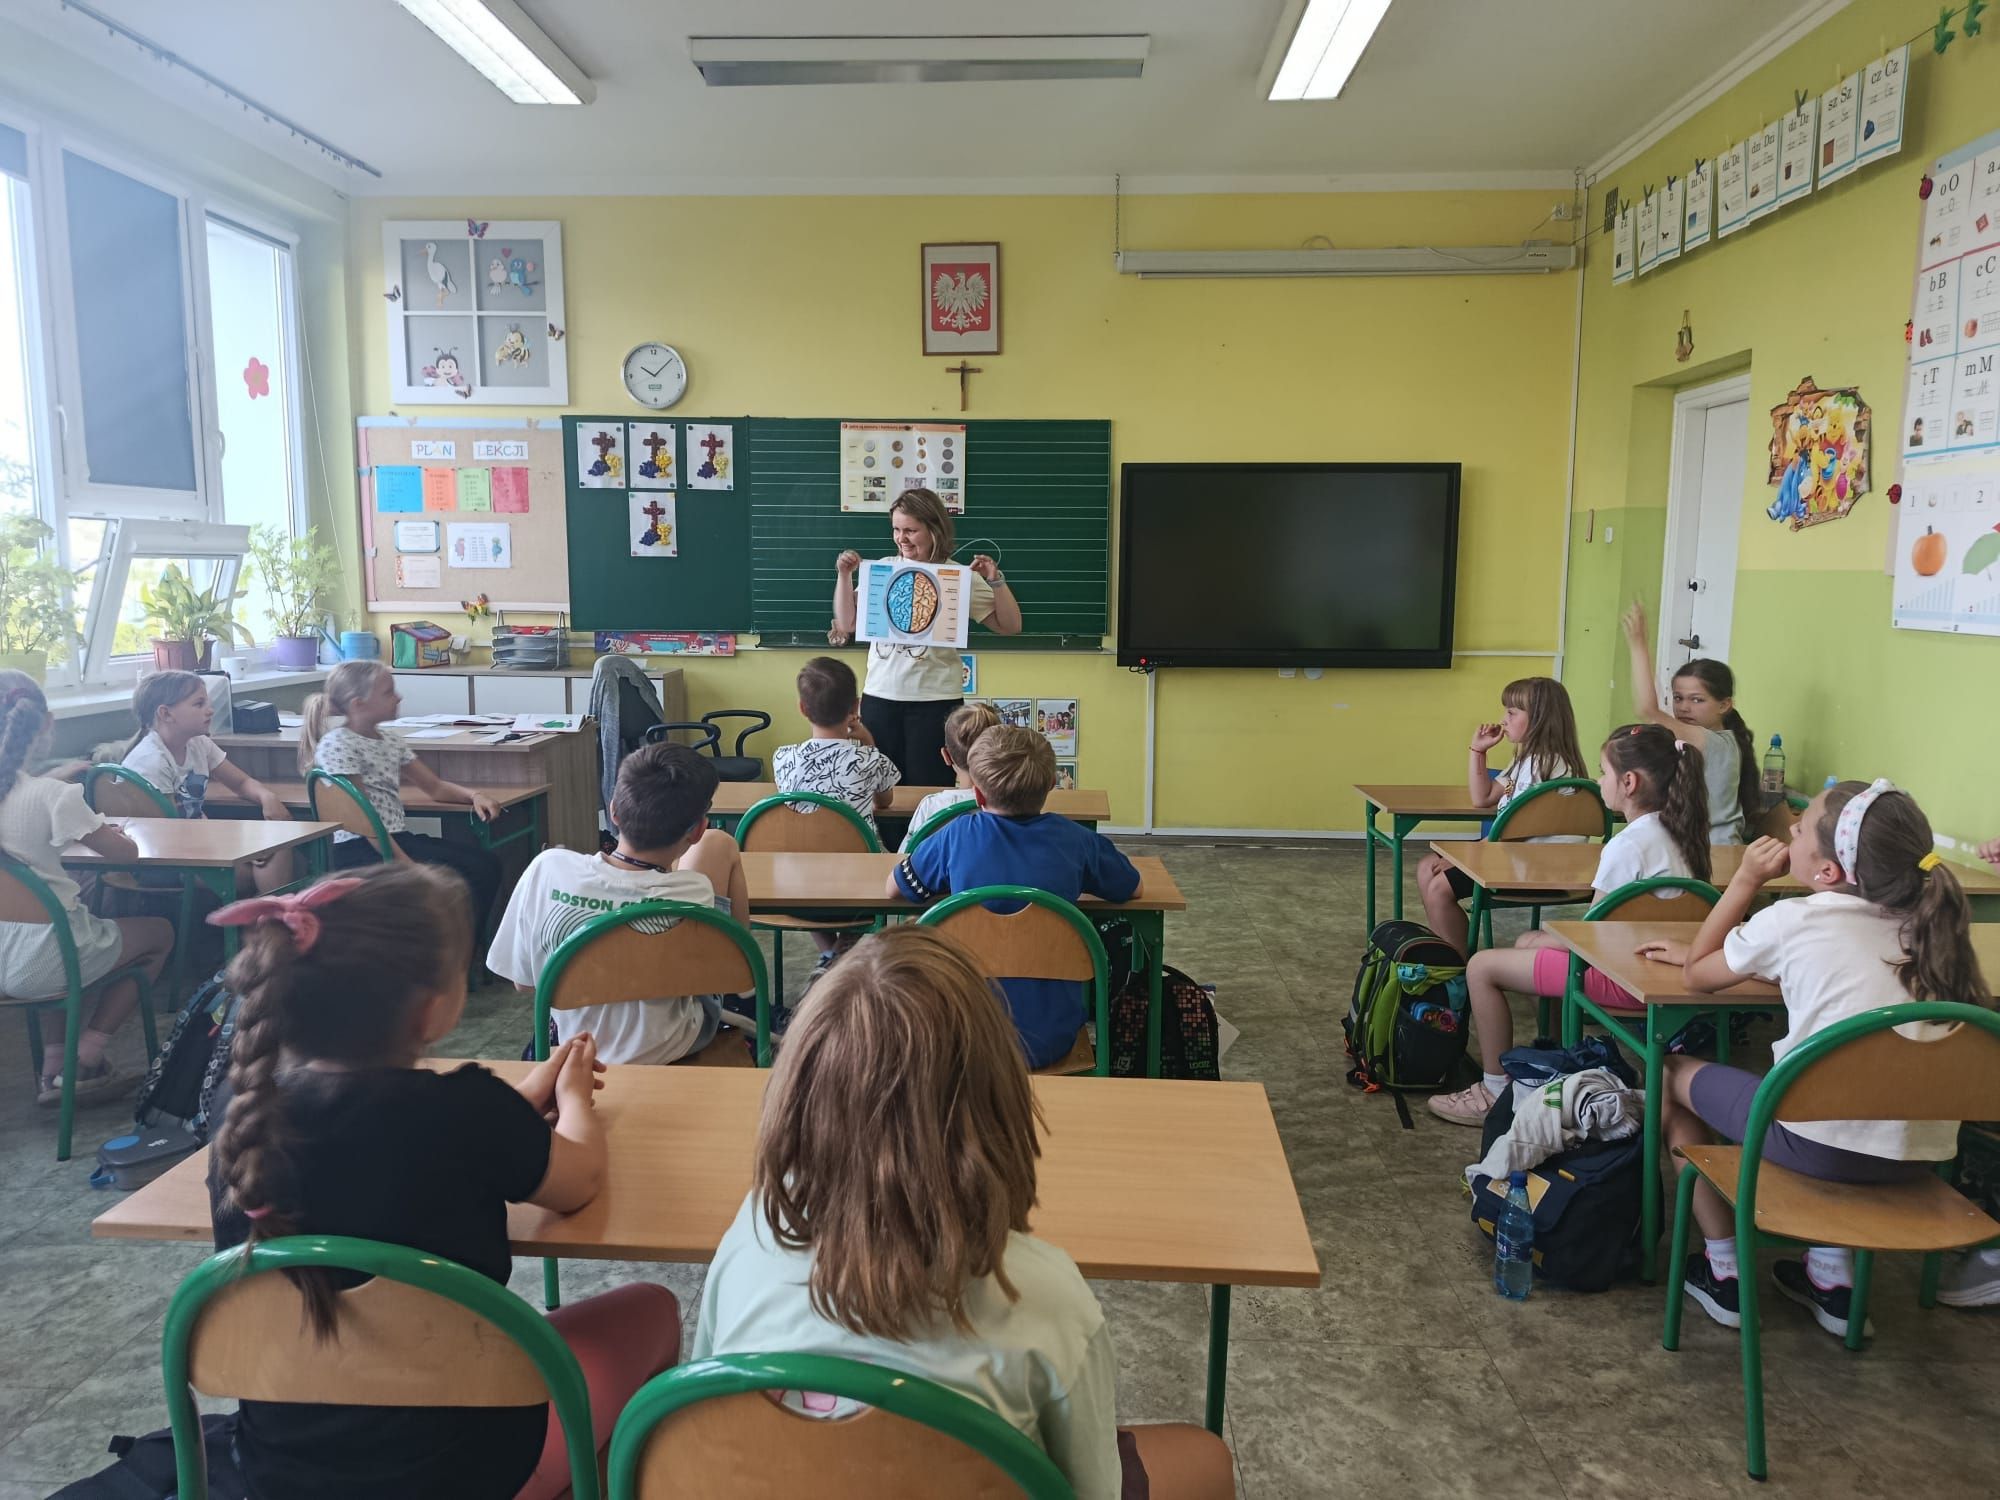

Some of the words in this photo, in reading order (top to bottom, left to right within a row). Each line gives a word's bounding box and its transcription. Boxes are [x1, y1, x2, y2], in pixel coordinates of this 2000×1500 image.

[1871, 70, 1882, 85] cz
[1885, 59, 1899, 77] Cz
[1828, 96, 1838, 111] sz
[1840, 85, 1852, 104] Sz
[416, 444, 452, 457] PLAN
[478, 444, 524, 457] LEKCJI
[551, 888, 614, 912] BOSTON
